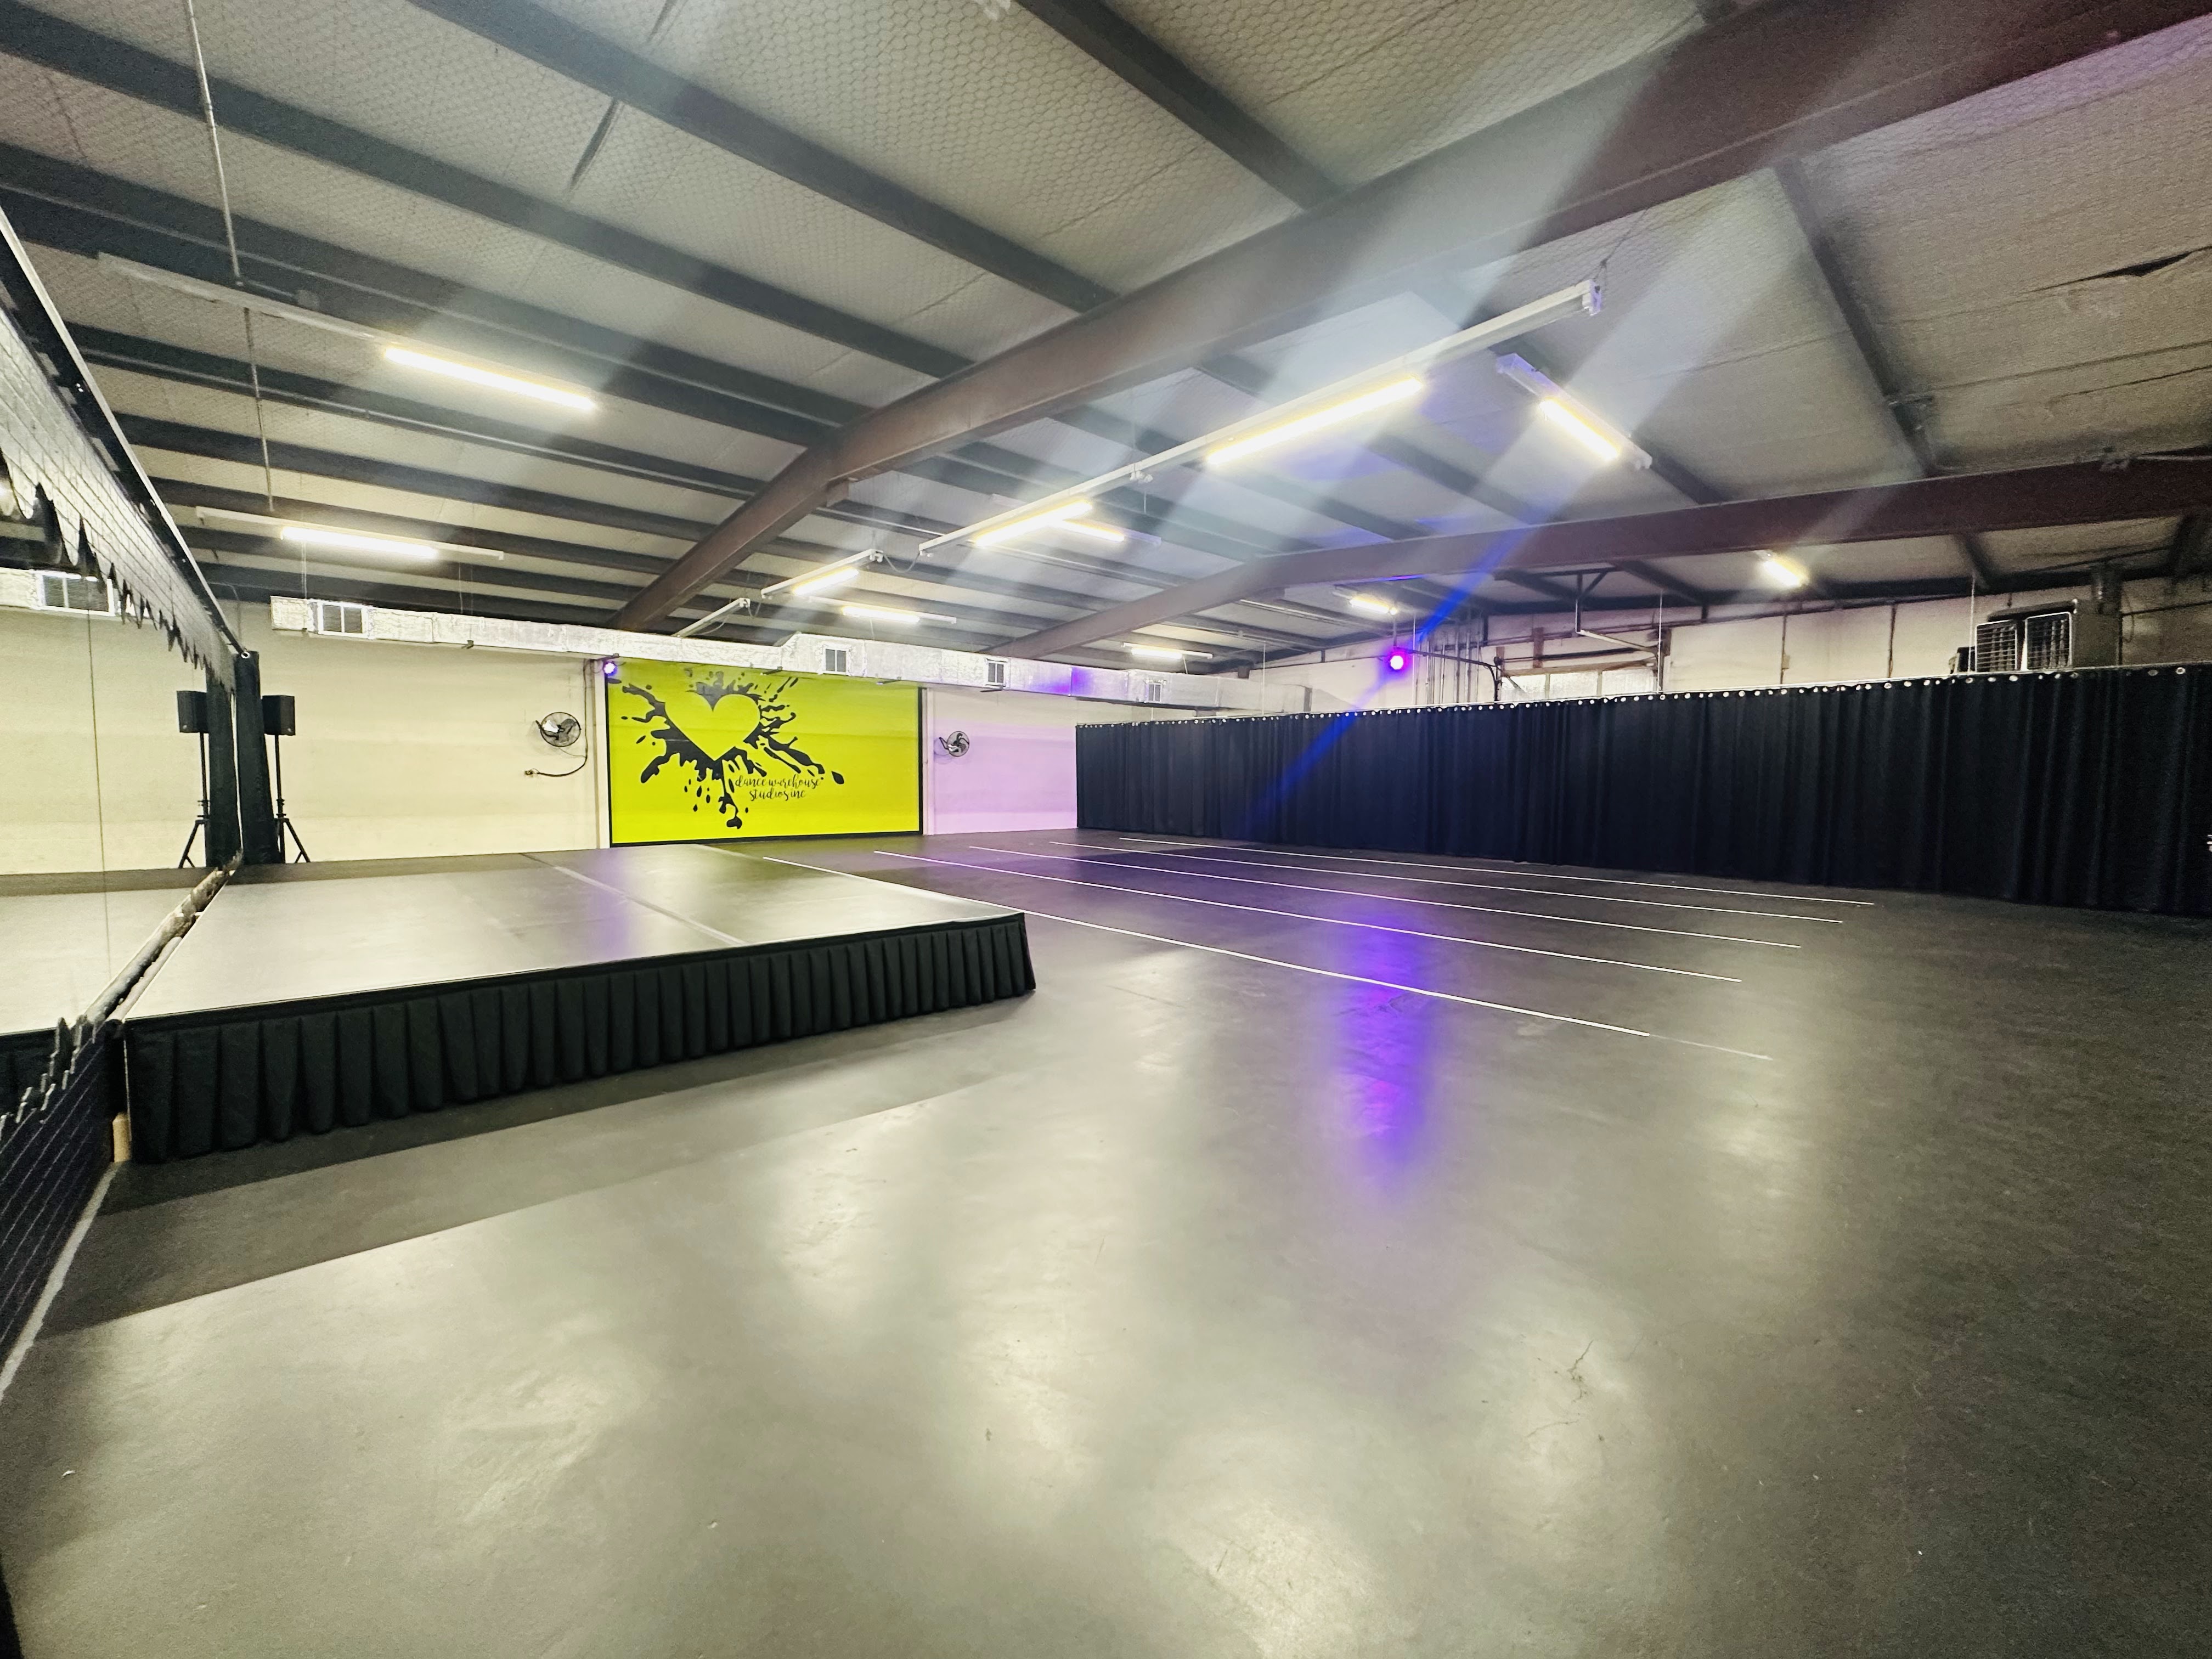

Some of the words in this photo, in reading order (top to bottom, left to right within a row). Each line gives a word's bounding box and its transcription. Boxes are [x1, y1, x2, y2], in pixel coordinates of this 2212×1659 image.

[735, 775, 766, 787] dance
[769, 774, 820, 789] warehouse
[749, 788, 788, 801] studios
[790, 788, 806, 798] inc
